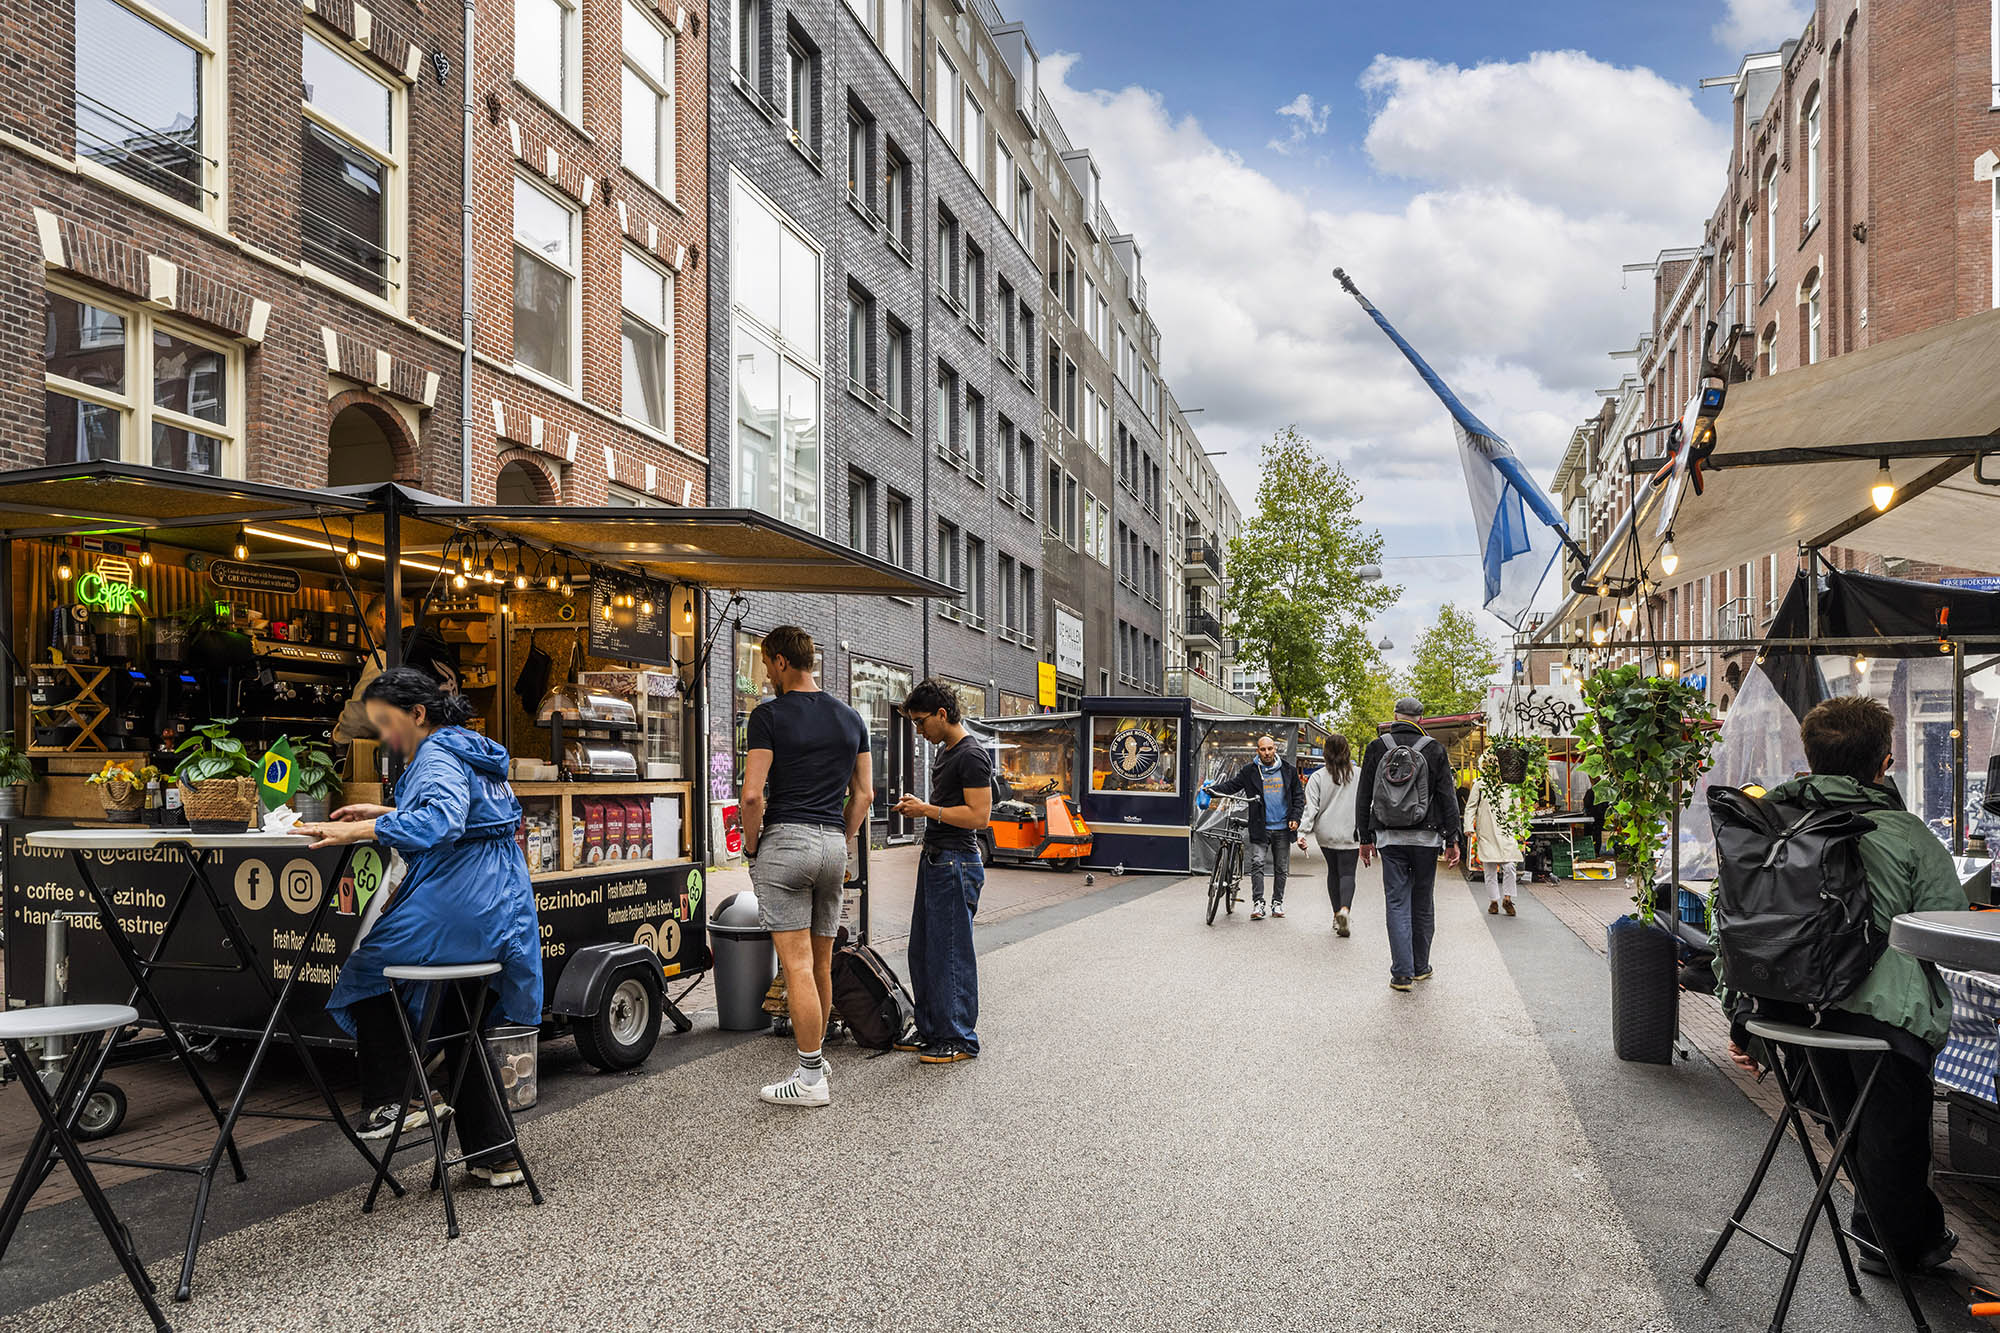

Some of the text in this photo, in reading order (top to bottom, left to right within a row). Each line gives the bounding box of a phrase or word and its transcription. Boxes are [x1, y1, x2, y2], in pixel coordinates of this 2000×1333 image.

[227, 574, 247, 583] GREAT
[79, 572, 146, 612] Coffe
[27, 882, 74, 902] coffee
[357, 868, 377, 892] GO
[535, 885, 603, 912] fezinho.nl
[273, 928, 290, 950] Fresh
[316, 931, 336, 954] Coffee
[306, 961, 330, 985] Pastries
